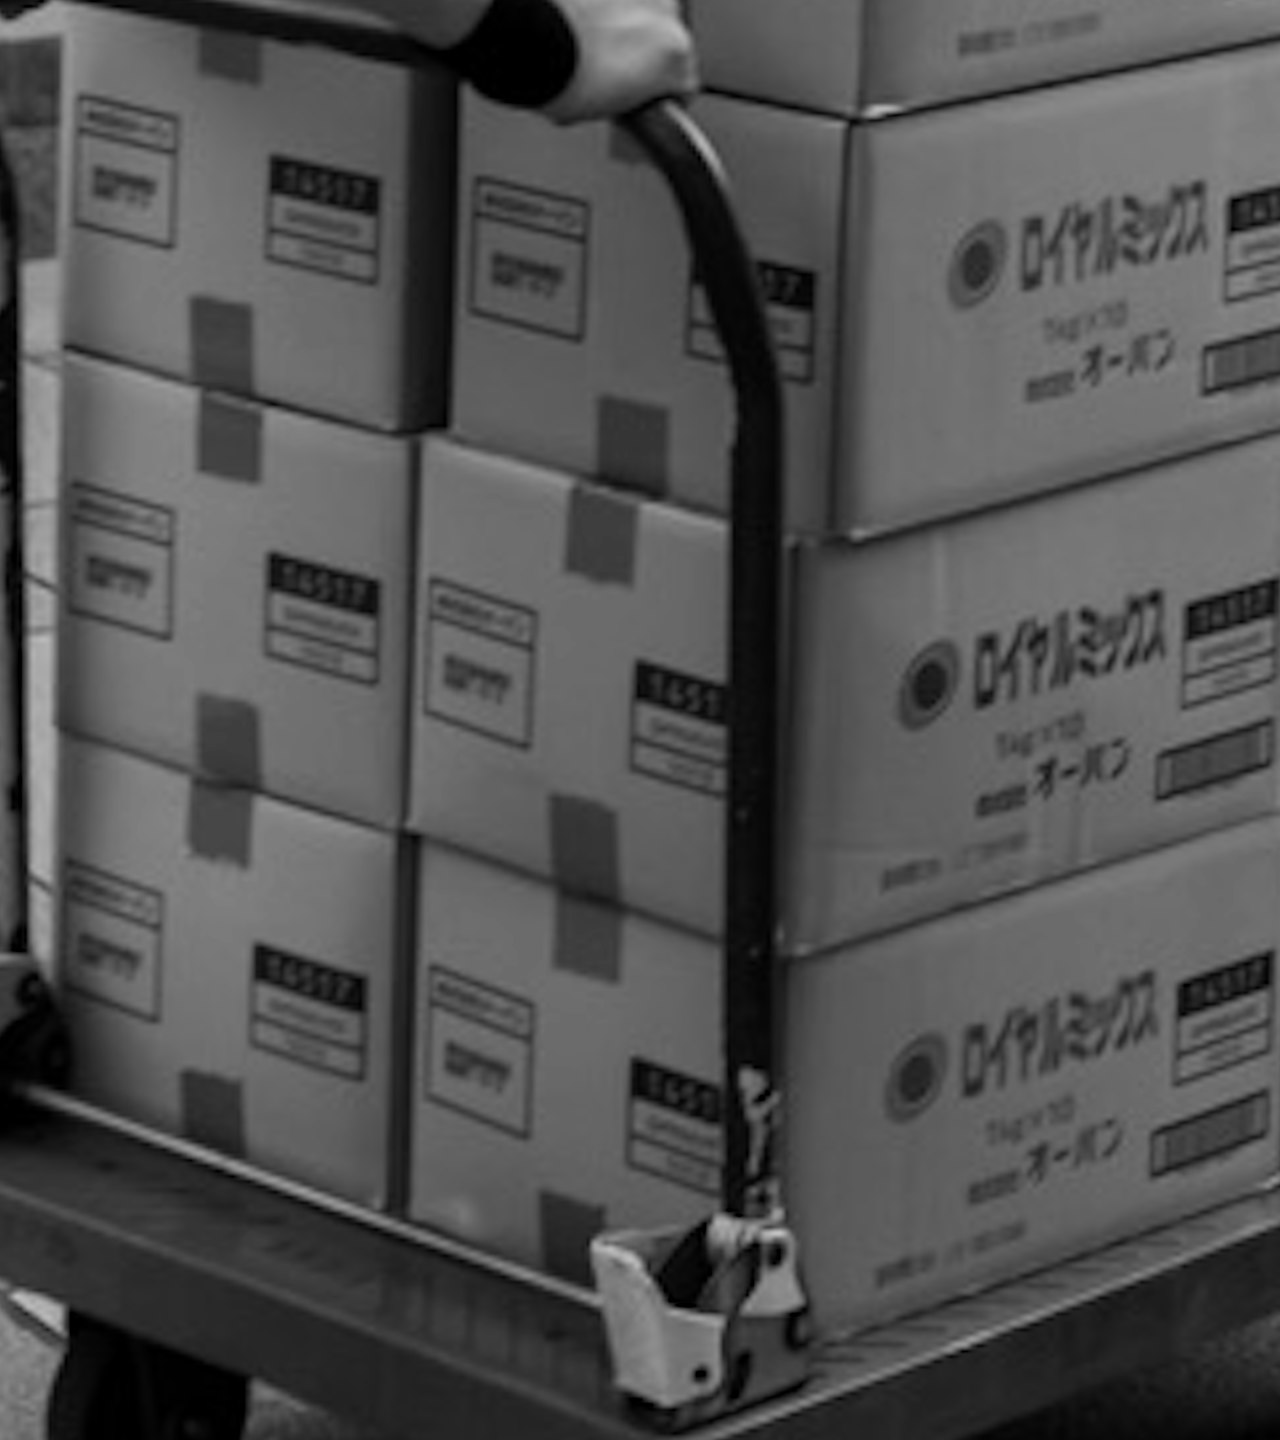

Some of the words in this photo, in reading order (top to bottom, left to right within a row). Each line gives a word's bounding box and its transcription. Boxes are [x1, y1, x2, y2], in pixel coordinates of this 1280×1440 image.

[1019, 178, 1209, 292] ロイヤルミックス
[973, 587, 1166, 712] ロイヤルミックス
[962, 967, 1160, 1099] ロイヤルミックス
